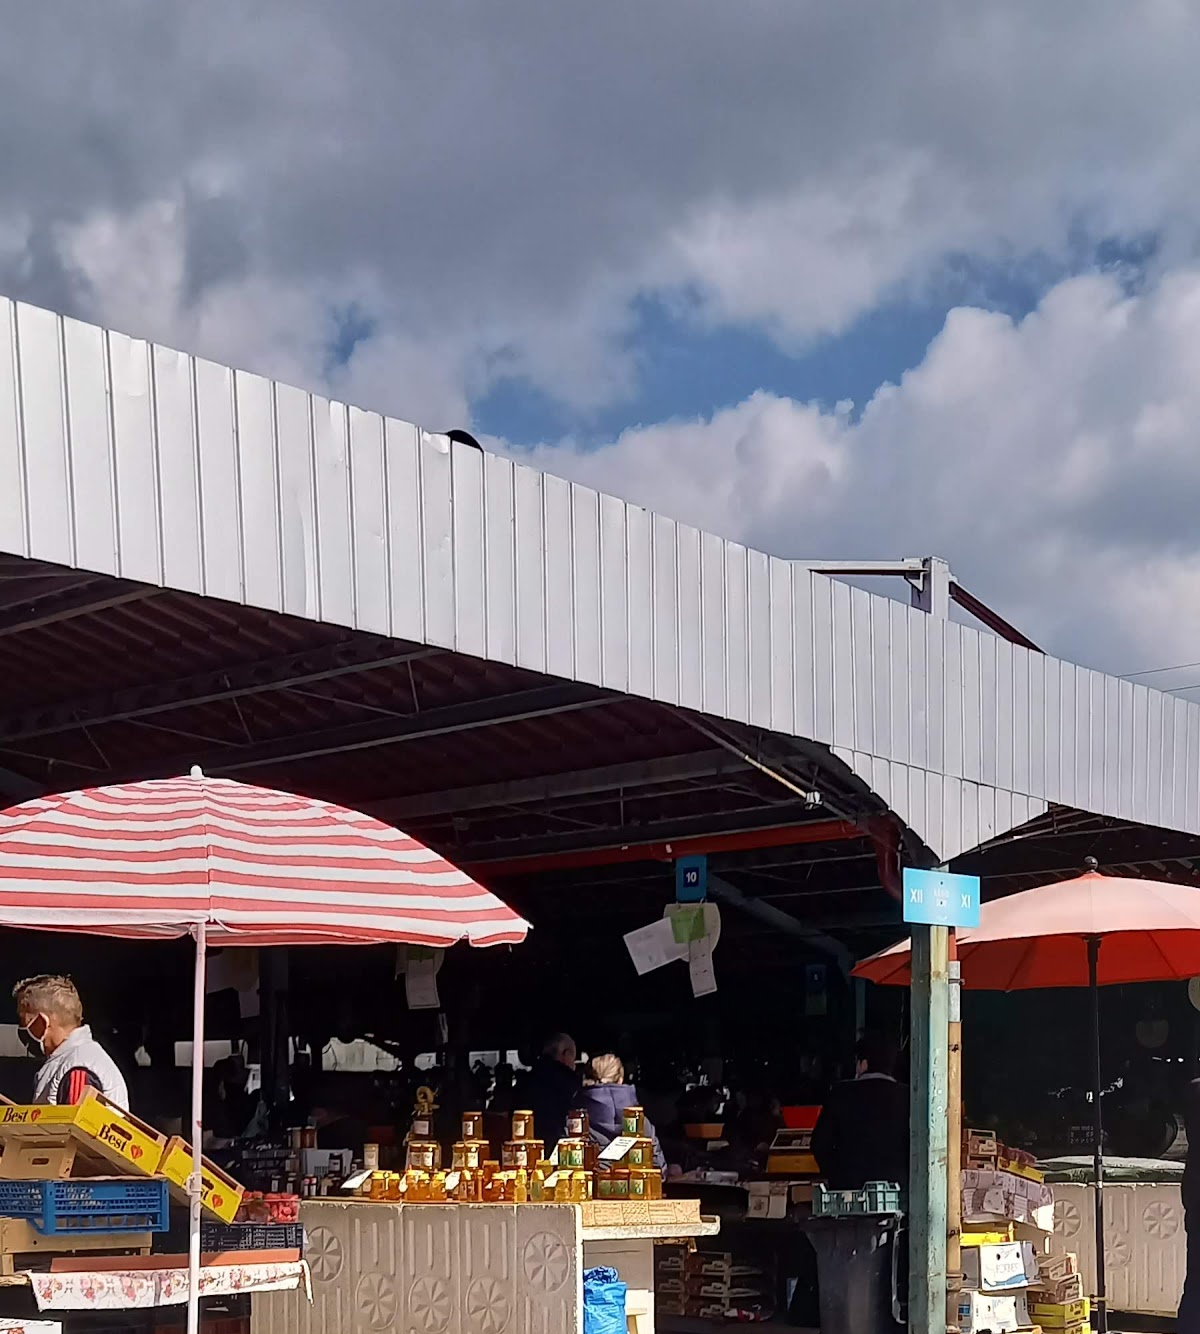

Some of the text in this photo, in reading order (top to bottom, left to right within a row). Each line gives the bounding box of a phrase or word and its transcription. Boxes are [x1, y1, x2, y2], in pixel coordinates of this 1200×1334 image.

[686, 871, 697, 883] 10
[910, 888, 923, 904] XII
[961, 893, 971, 909] XI
[3, 1107, 28, 1122] Best
[99, 1123, 127, 1152] Best
